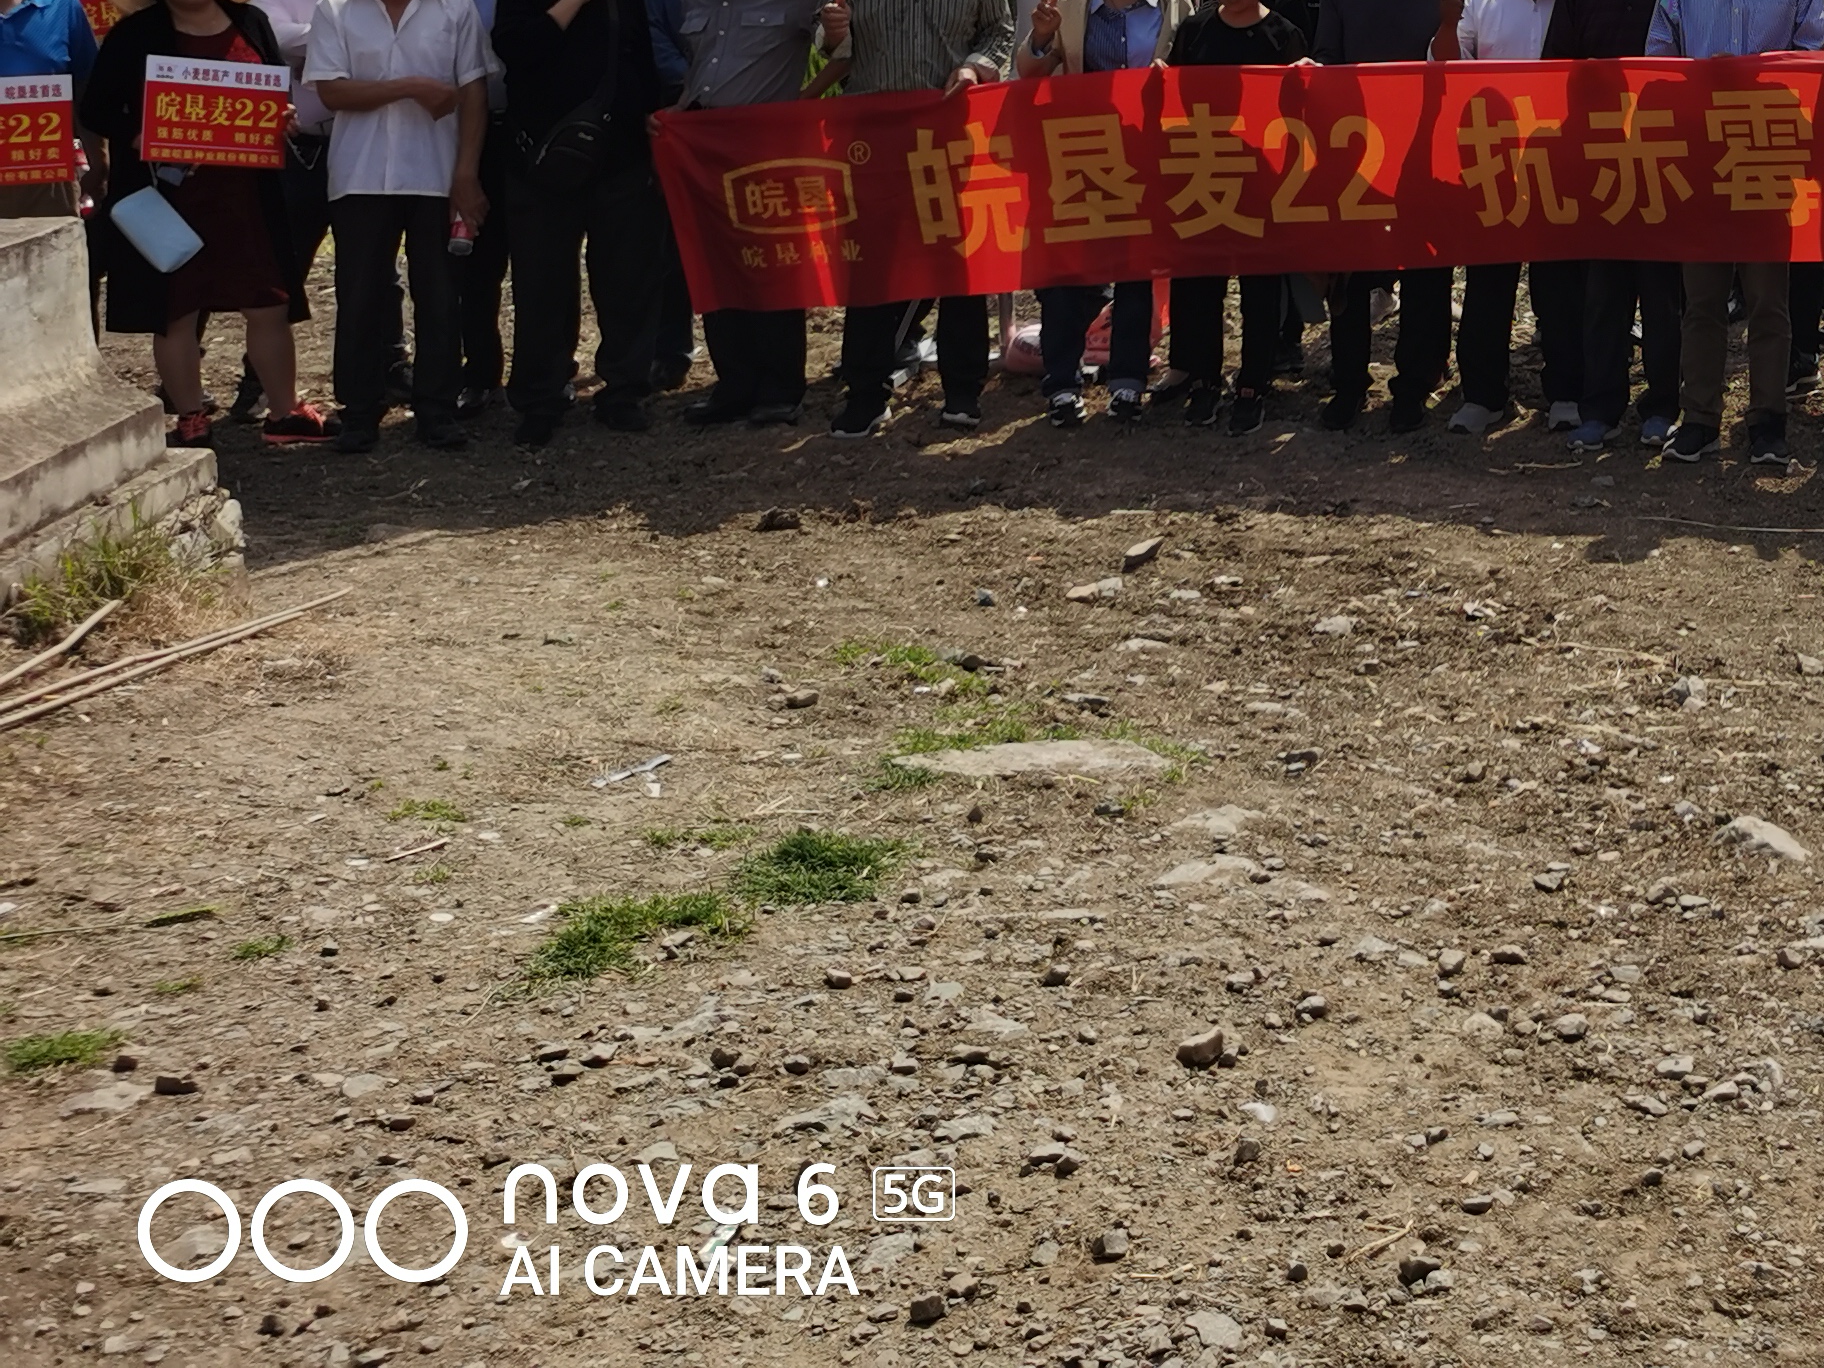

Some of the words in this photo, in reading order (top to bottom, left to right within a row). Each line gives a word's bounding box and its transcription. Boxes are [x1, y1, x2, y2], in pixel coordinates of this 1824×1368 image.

[155, 91, 279, 129] 皖垦麦22
[744, 174, 837, 219] 皖垦
[906, 102, 1400, 259] 皖垦麦22
[741, 239, 864, 268] 皖垦种业
